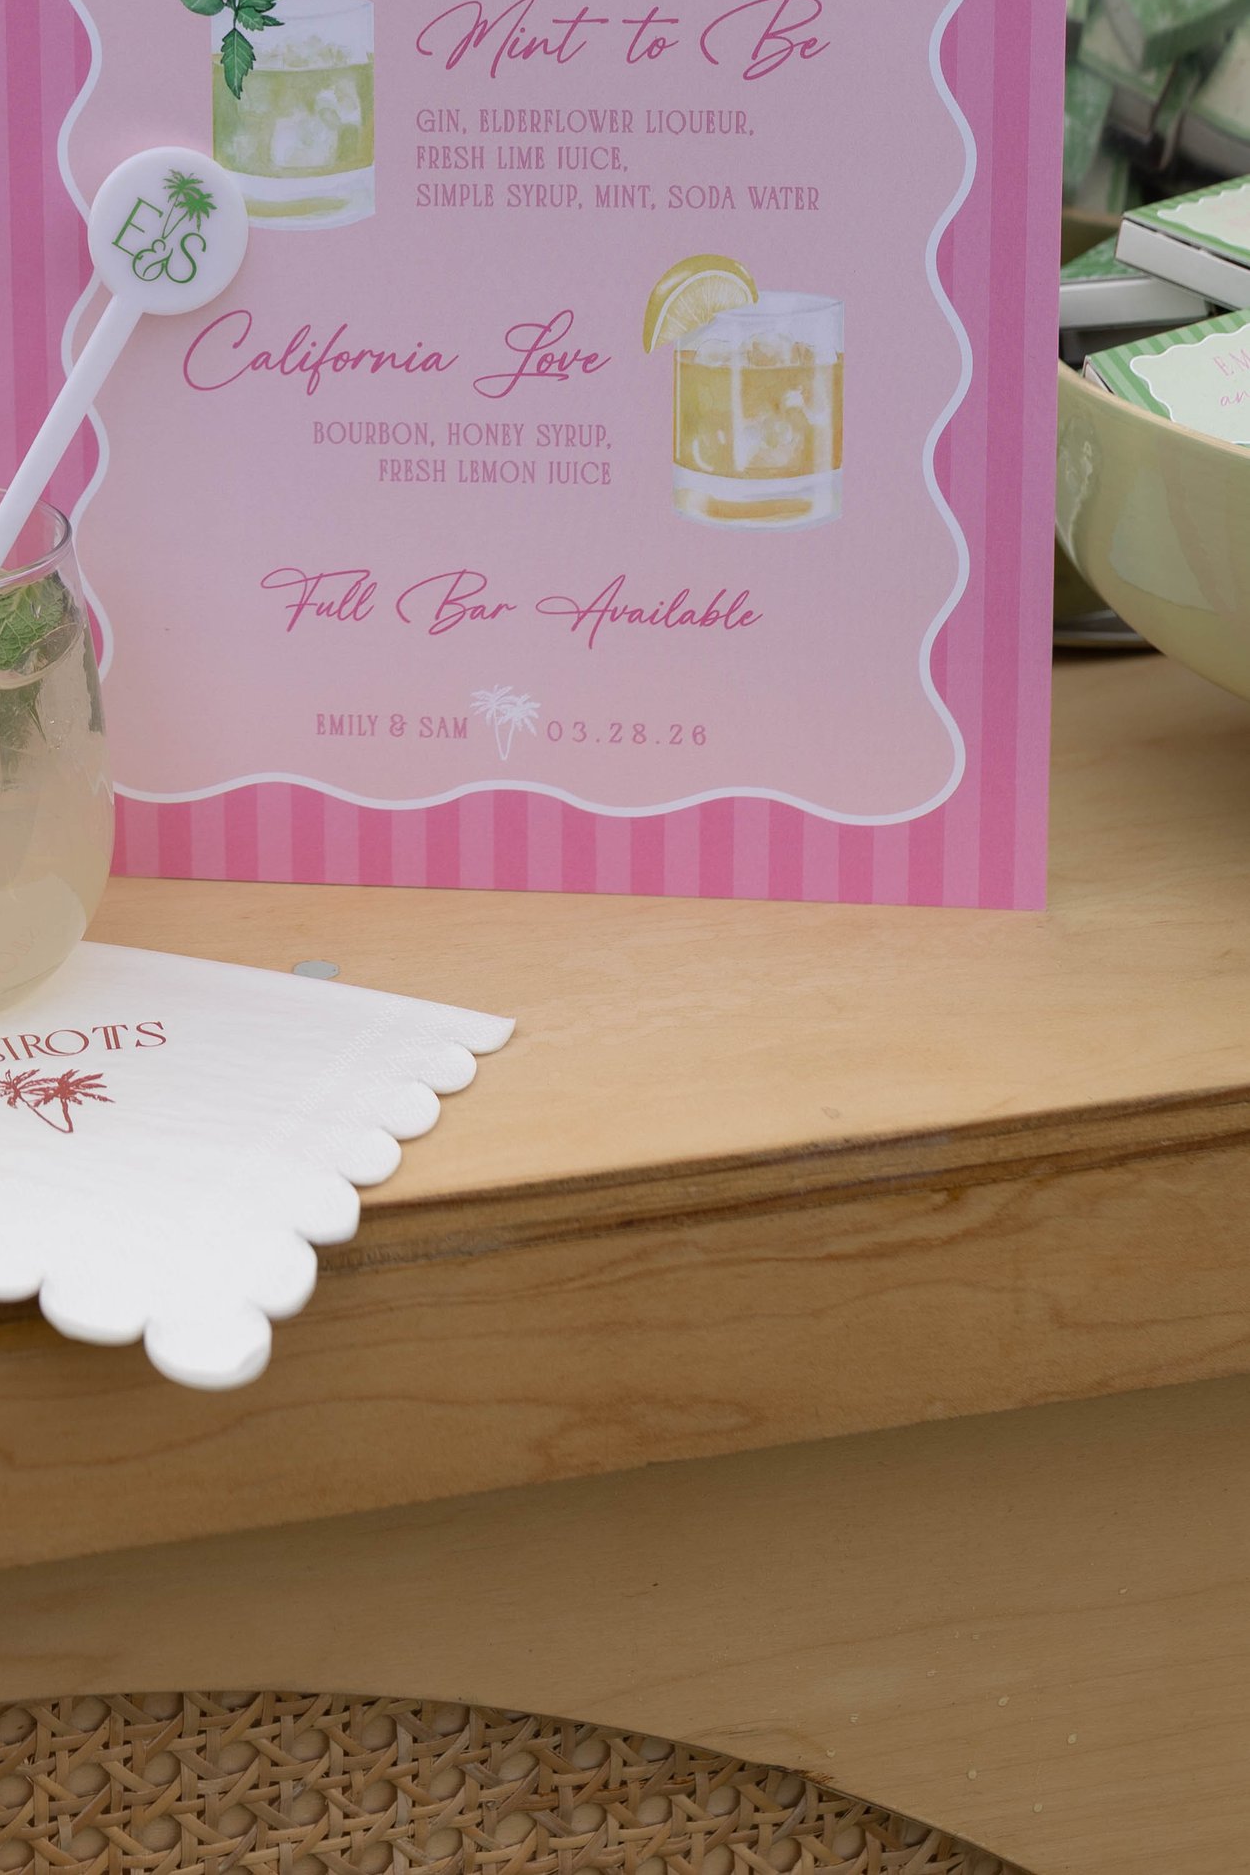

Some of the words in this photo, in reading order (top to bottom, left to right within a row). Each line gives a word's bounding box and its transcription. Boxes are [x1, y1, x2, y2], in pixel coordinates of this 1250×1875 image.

[622, 6, 679, 65] to
[415, 108, 468, 135] GIN,
[478, 108, 635, 135] ELDERFLOWER
[645, 109, 755, 137] LIQUEUR,
[415, 145, 486, 171] FRESH
[496, 145, 546, 171] LIME
[556, 145, 629, 173] JUICE,
[415, 183, 495, 208] SIMPLE
[506, 184, 583, 210] SYRUP,
[594, 185, 656, 212] MINT,
[667, 185, 737, 211] SODA
[747, 185, 821, 212] WATER
[111, 196, 207, 284] E&S
[183, 308, 459, 397] California
[473, 308, 612, 400] Love
[312, 421, 436, 448] BOURBON,
[447, 422, 525, 447] HONEY
[535, 424, 613, 451] SYRUP,
[377, 458, 446, 483] FRESH
[457, 460, 537, 485] LEMON
[547, 460, 612, 486] JUICE
[260, 567, 378, 633] Full
[395, 568, 517, 636] Bar
[534, 574, 763, 650] Available
[315, 713, 379, 738] EMILY
[389, 713, 408, 739] &
[418, 715, 469, 740] SAM
[546, 720, 708, 747] 03.28.26
